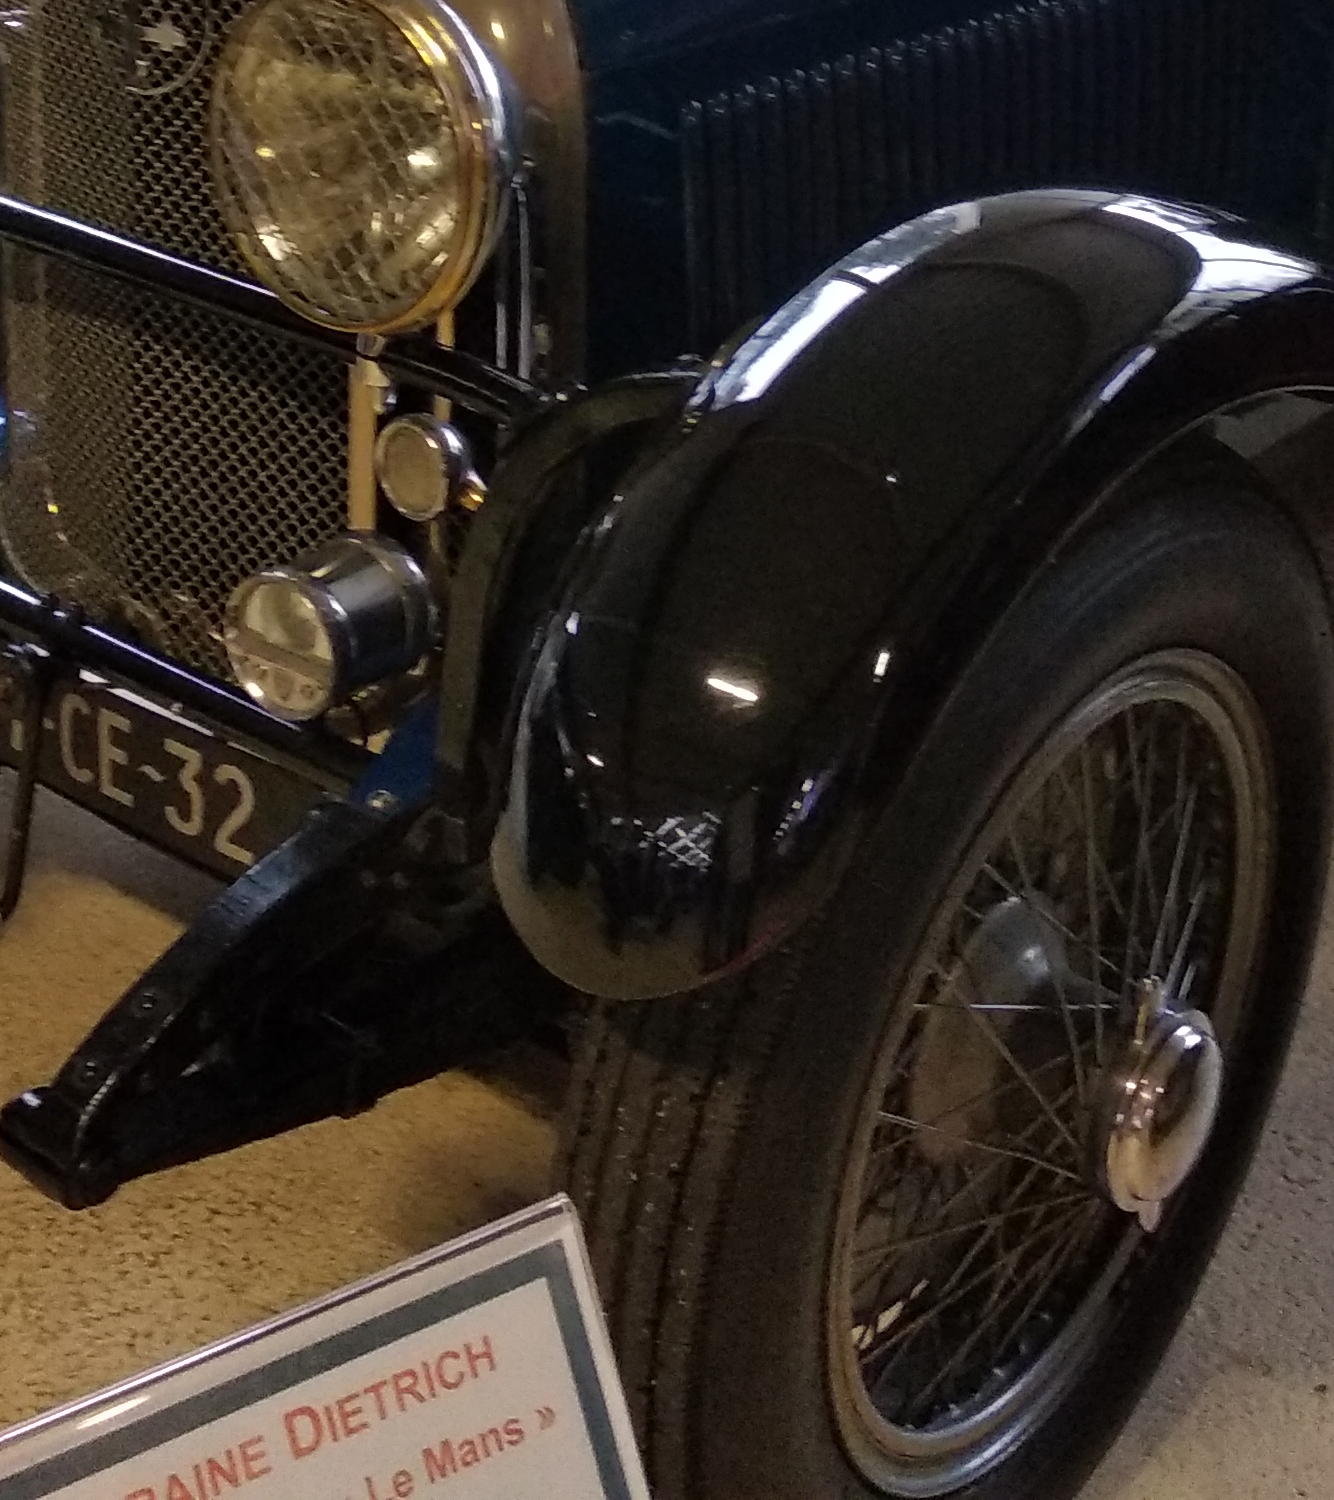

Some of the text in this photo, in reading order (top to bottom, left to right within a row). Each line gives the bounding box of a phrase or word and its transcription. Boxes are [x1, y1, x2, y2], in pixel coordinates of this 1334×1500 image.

[282, 1335, 497, 1460] DIETRICH
[364, 1468, 415, 1500] Le
[422, 1417, 525, 1484] Mans
